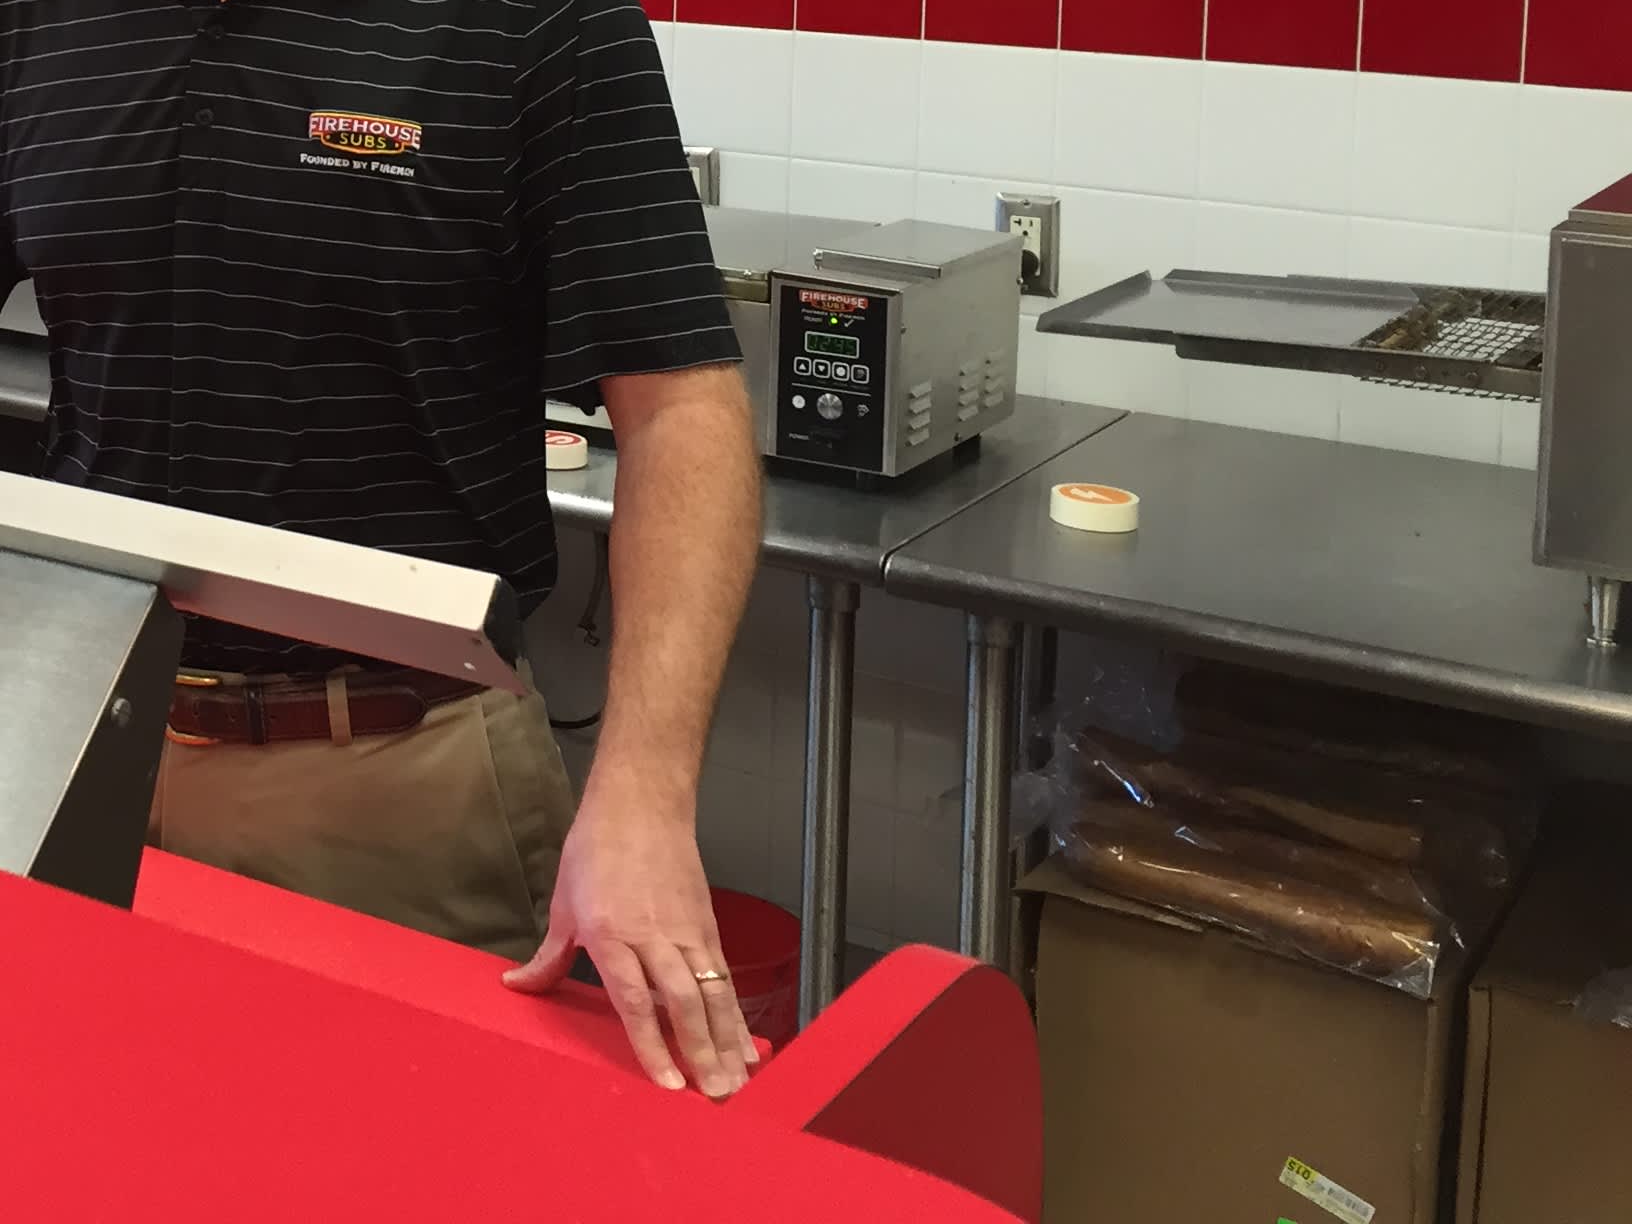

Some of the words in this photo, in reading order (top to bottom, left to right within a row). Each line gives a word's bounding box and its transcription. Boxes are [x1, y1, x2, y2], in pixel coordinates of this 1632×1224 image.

[309, 116, 422, 150] FIREHOUSE
[339, 133, 387, 149] SUBS
[801, 291, 866, 309] FIREHOUSE
